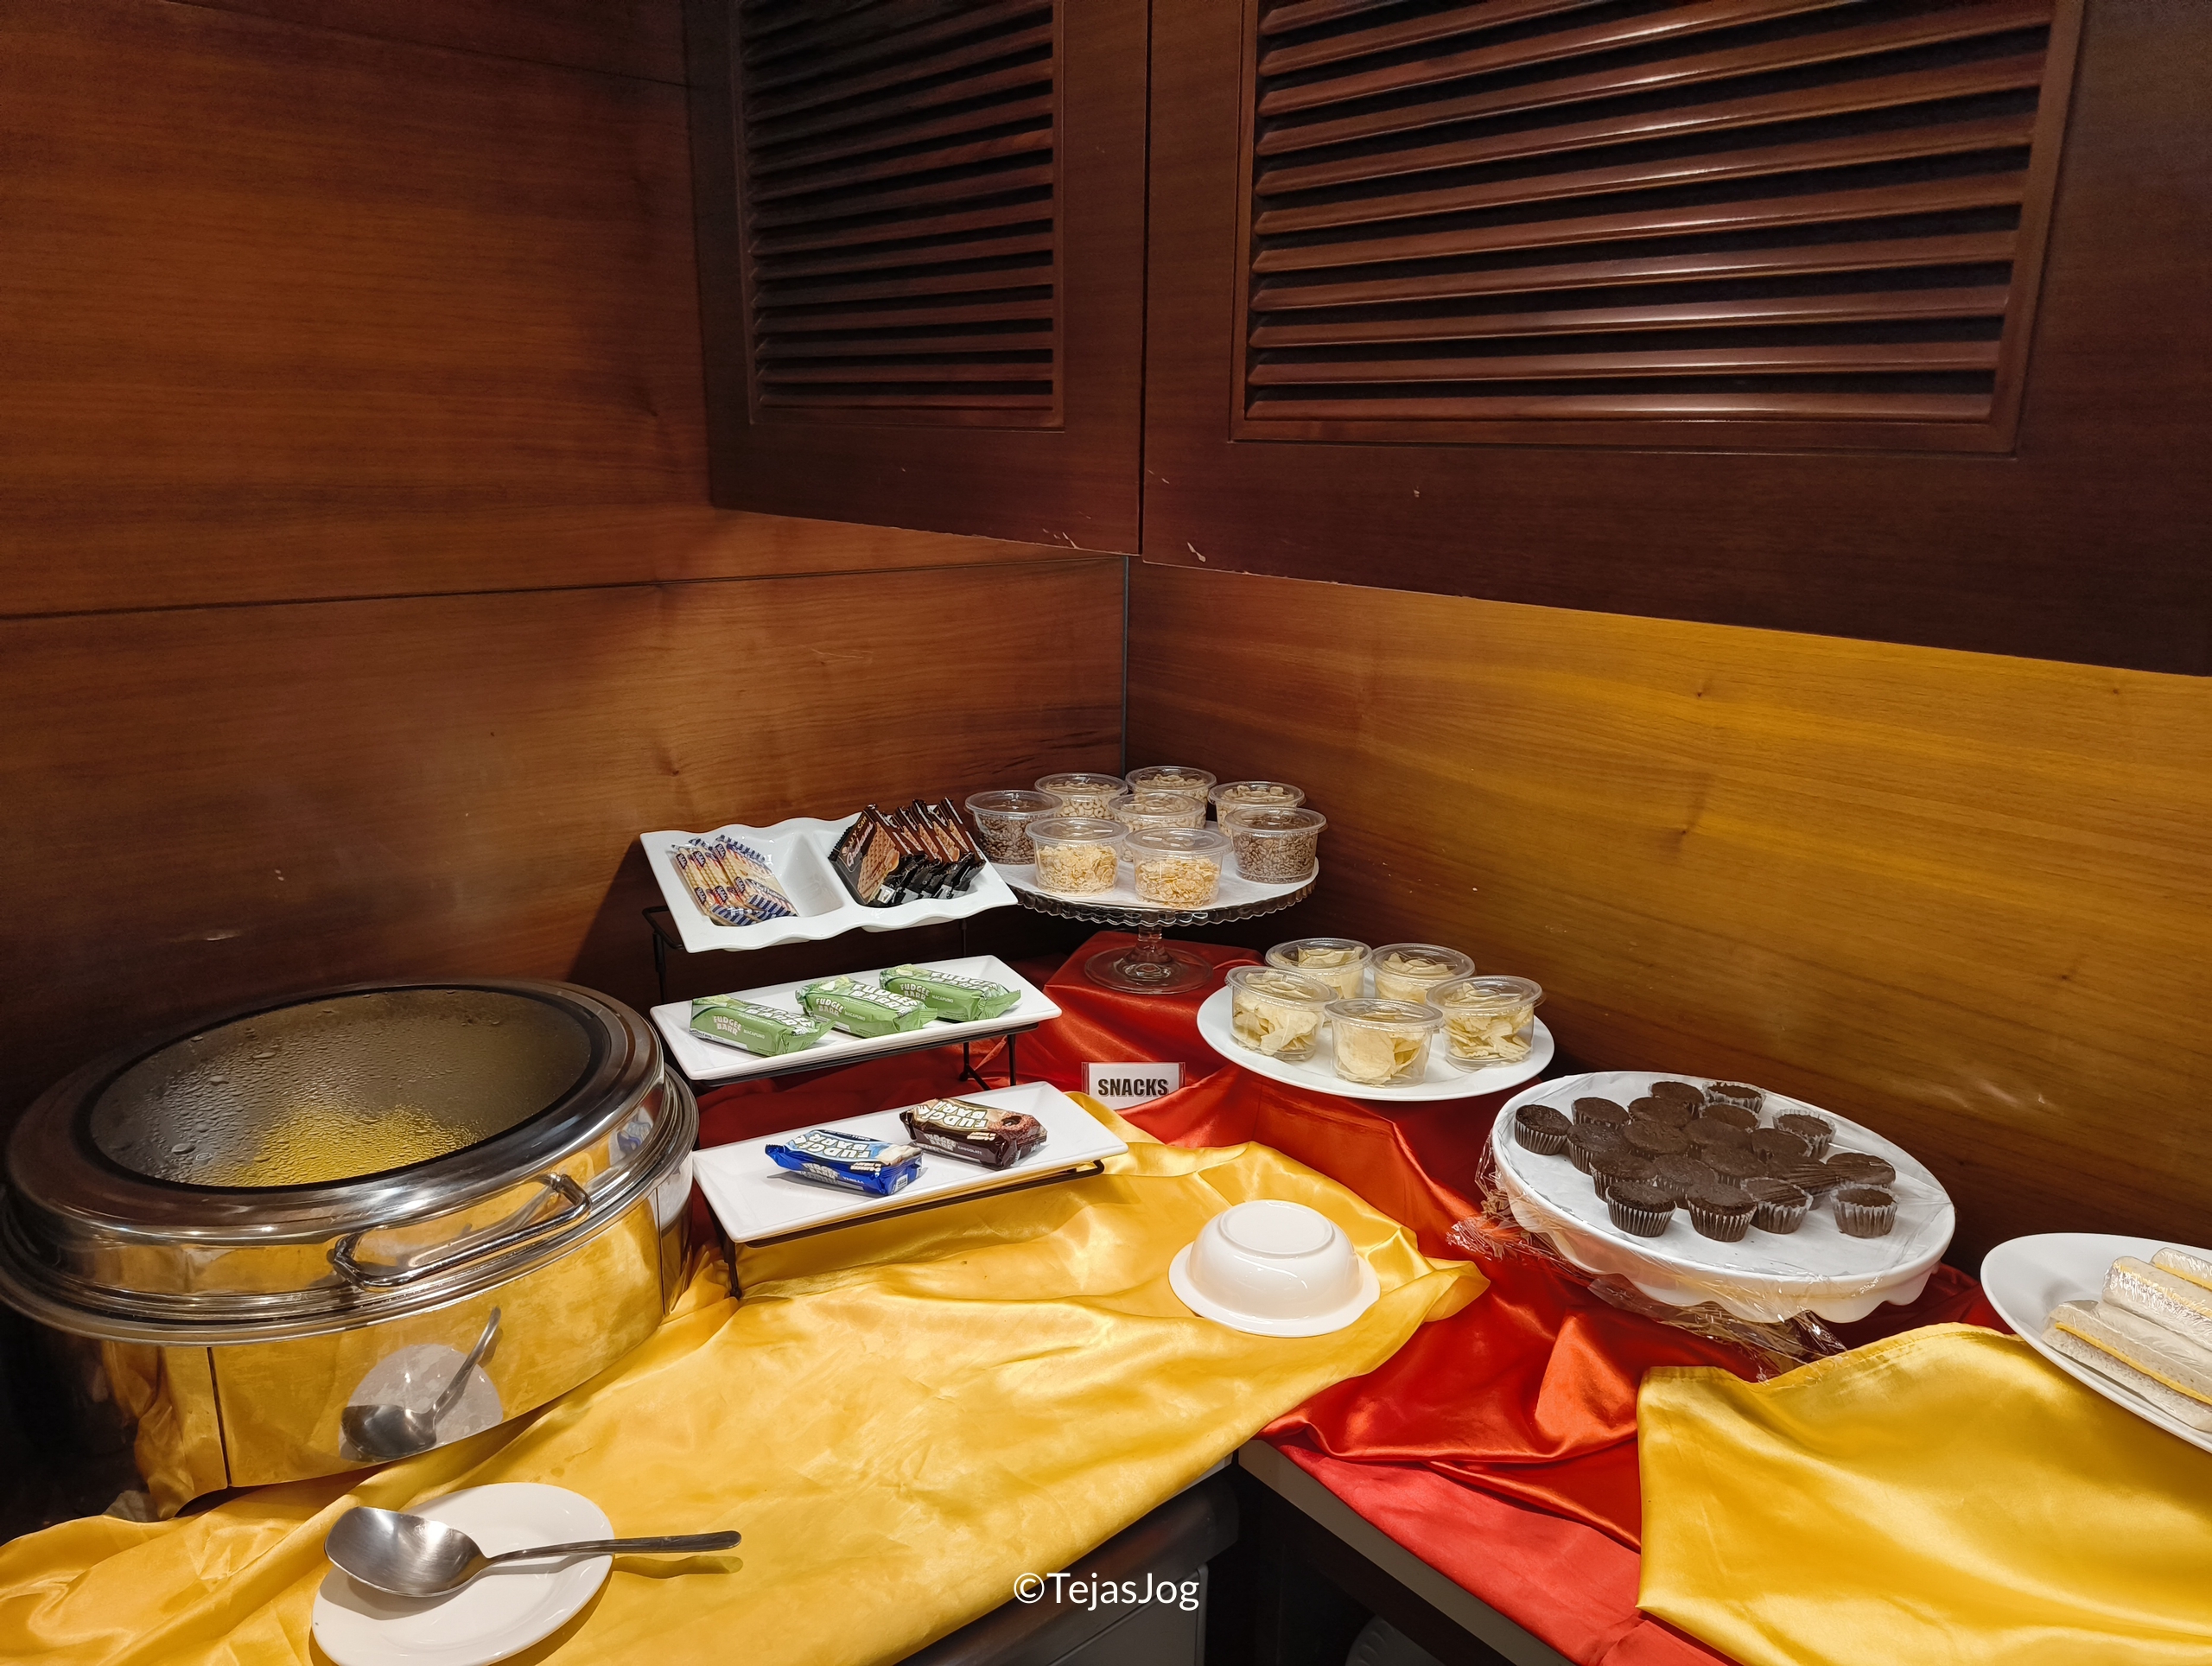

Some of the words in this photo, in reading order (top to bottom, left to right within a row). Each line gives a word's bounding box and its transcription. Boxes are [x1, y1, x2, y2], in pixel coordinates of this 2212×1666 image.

[850, 983, 918, 1007] FUDGEE
[899, 982, 931, 996] FUDGEE
[904, 990, 926, 1002] BARR
[815, 997, 844, 1013] FUDGEE
[849, 990, 901, 1009] BARR
[818, 1004, 840, 1018] BARR
[713, 1014, 742, 1031] FUDGEE
[716, 1023, 739, 1036] BARR
[1097, 1078, 1170, 1097] SNACKS
[809, 1133, 868, 1151] BARR
